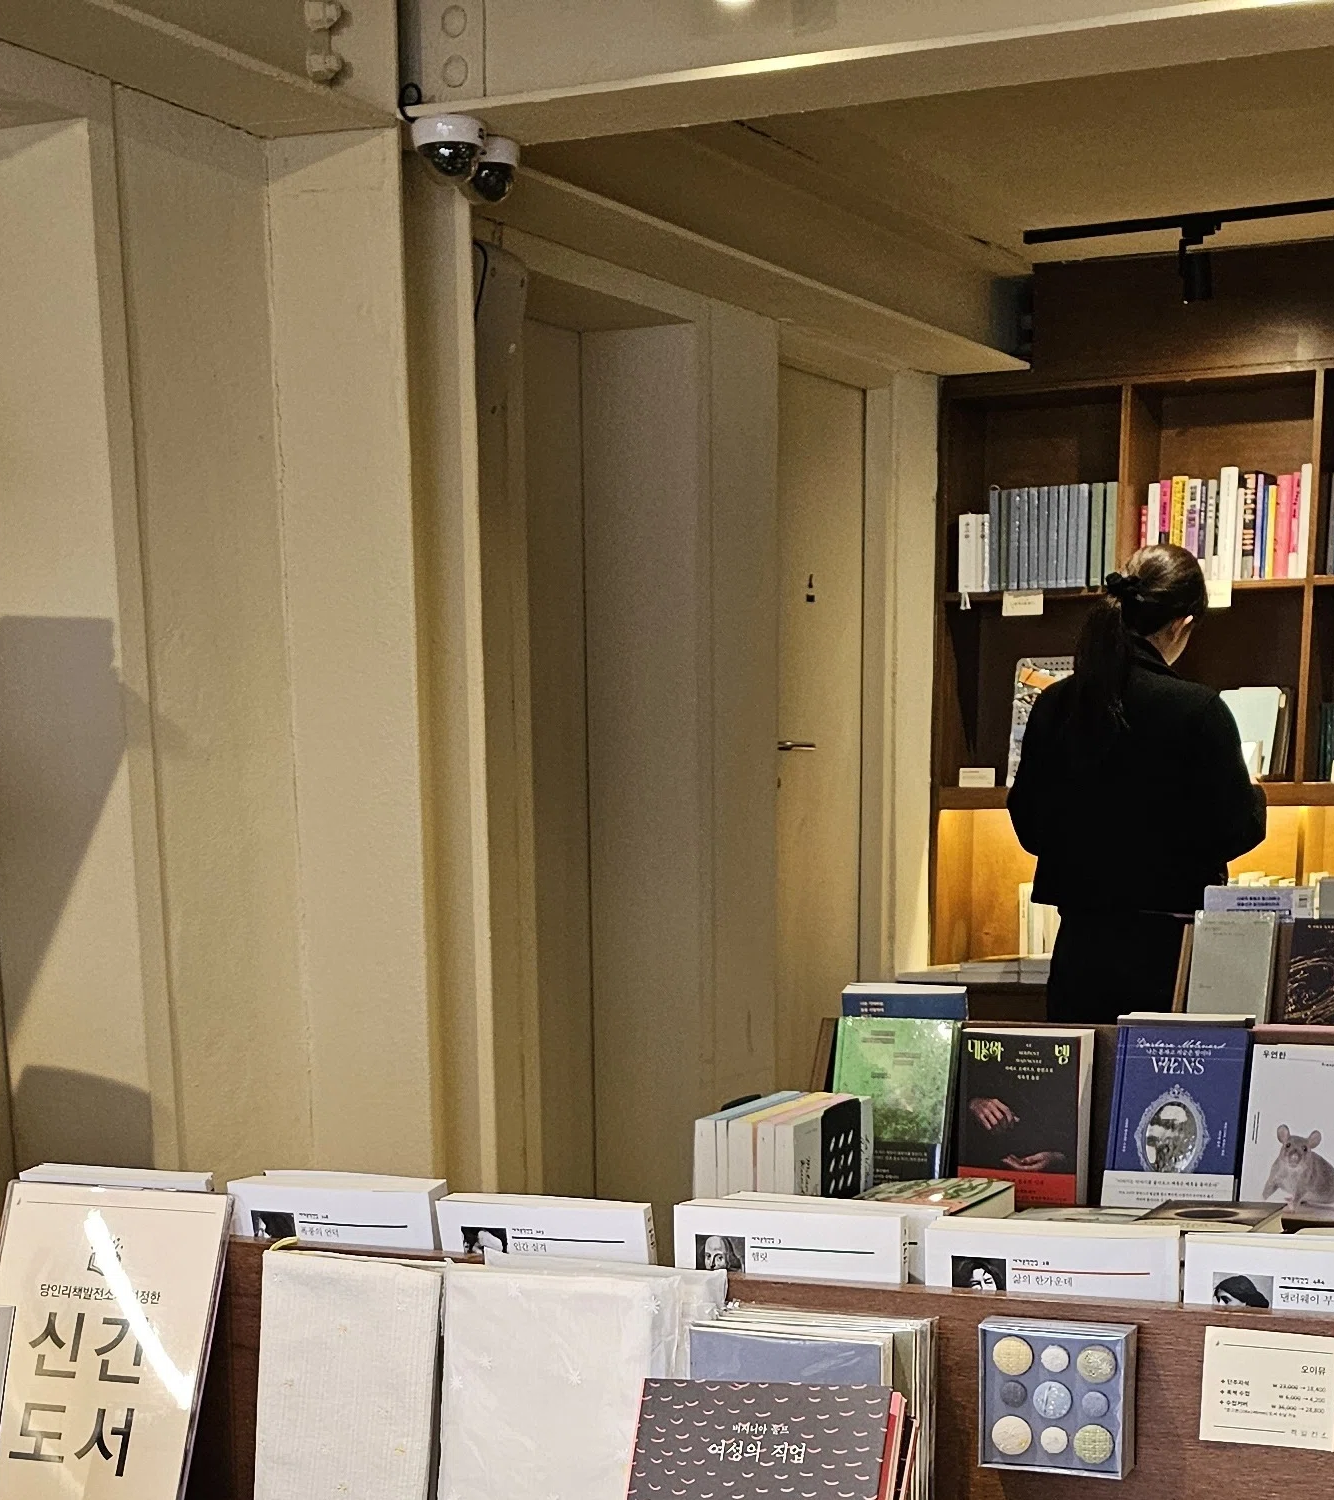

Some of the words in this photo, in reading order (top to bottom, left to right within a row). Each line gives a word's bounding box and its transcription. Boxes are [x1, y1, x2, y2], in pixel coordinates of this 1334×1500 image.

[1263, 1051, 1286, 1061] 우연한
[1151, 1057, 1205, 1075] VIENS
[299, 1226, 322, 1238] 폭풍의
[324, 1227, 340, 1238] 언덕
[513, 1241, 529, 1253] 인간
[531, 1242, 547, 1254] 실격
[751, 1250, 769, 1263] 햄릿
[1012, 1273, 1032, 1287] 삶의
[1035, 1274, 1074, 1288] 한가운데
[40, 1283, 125, 1302] 당인리책발전소
[1279, 1292, 1320, 1306] 댈러웨이
[28, 1312, 151, 1385] 신간
[1300, 1365, 1326, 1376] 오이뮤
[732, 1422, 767, 1436] 버지니아
[9, 1402, 135, 1478] 도서
[707, 1440, 761, 1463] 여성의
[772, 1441, 806, 1464] 직업
